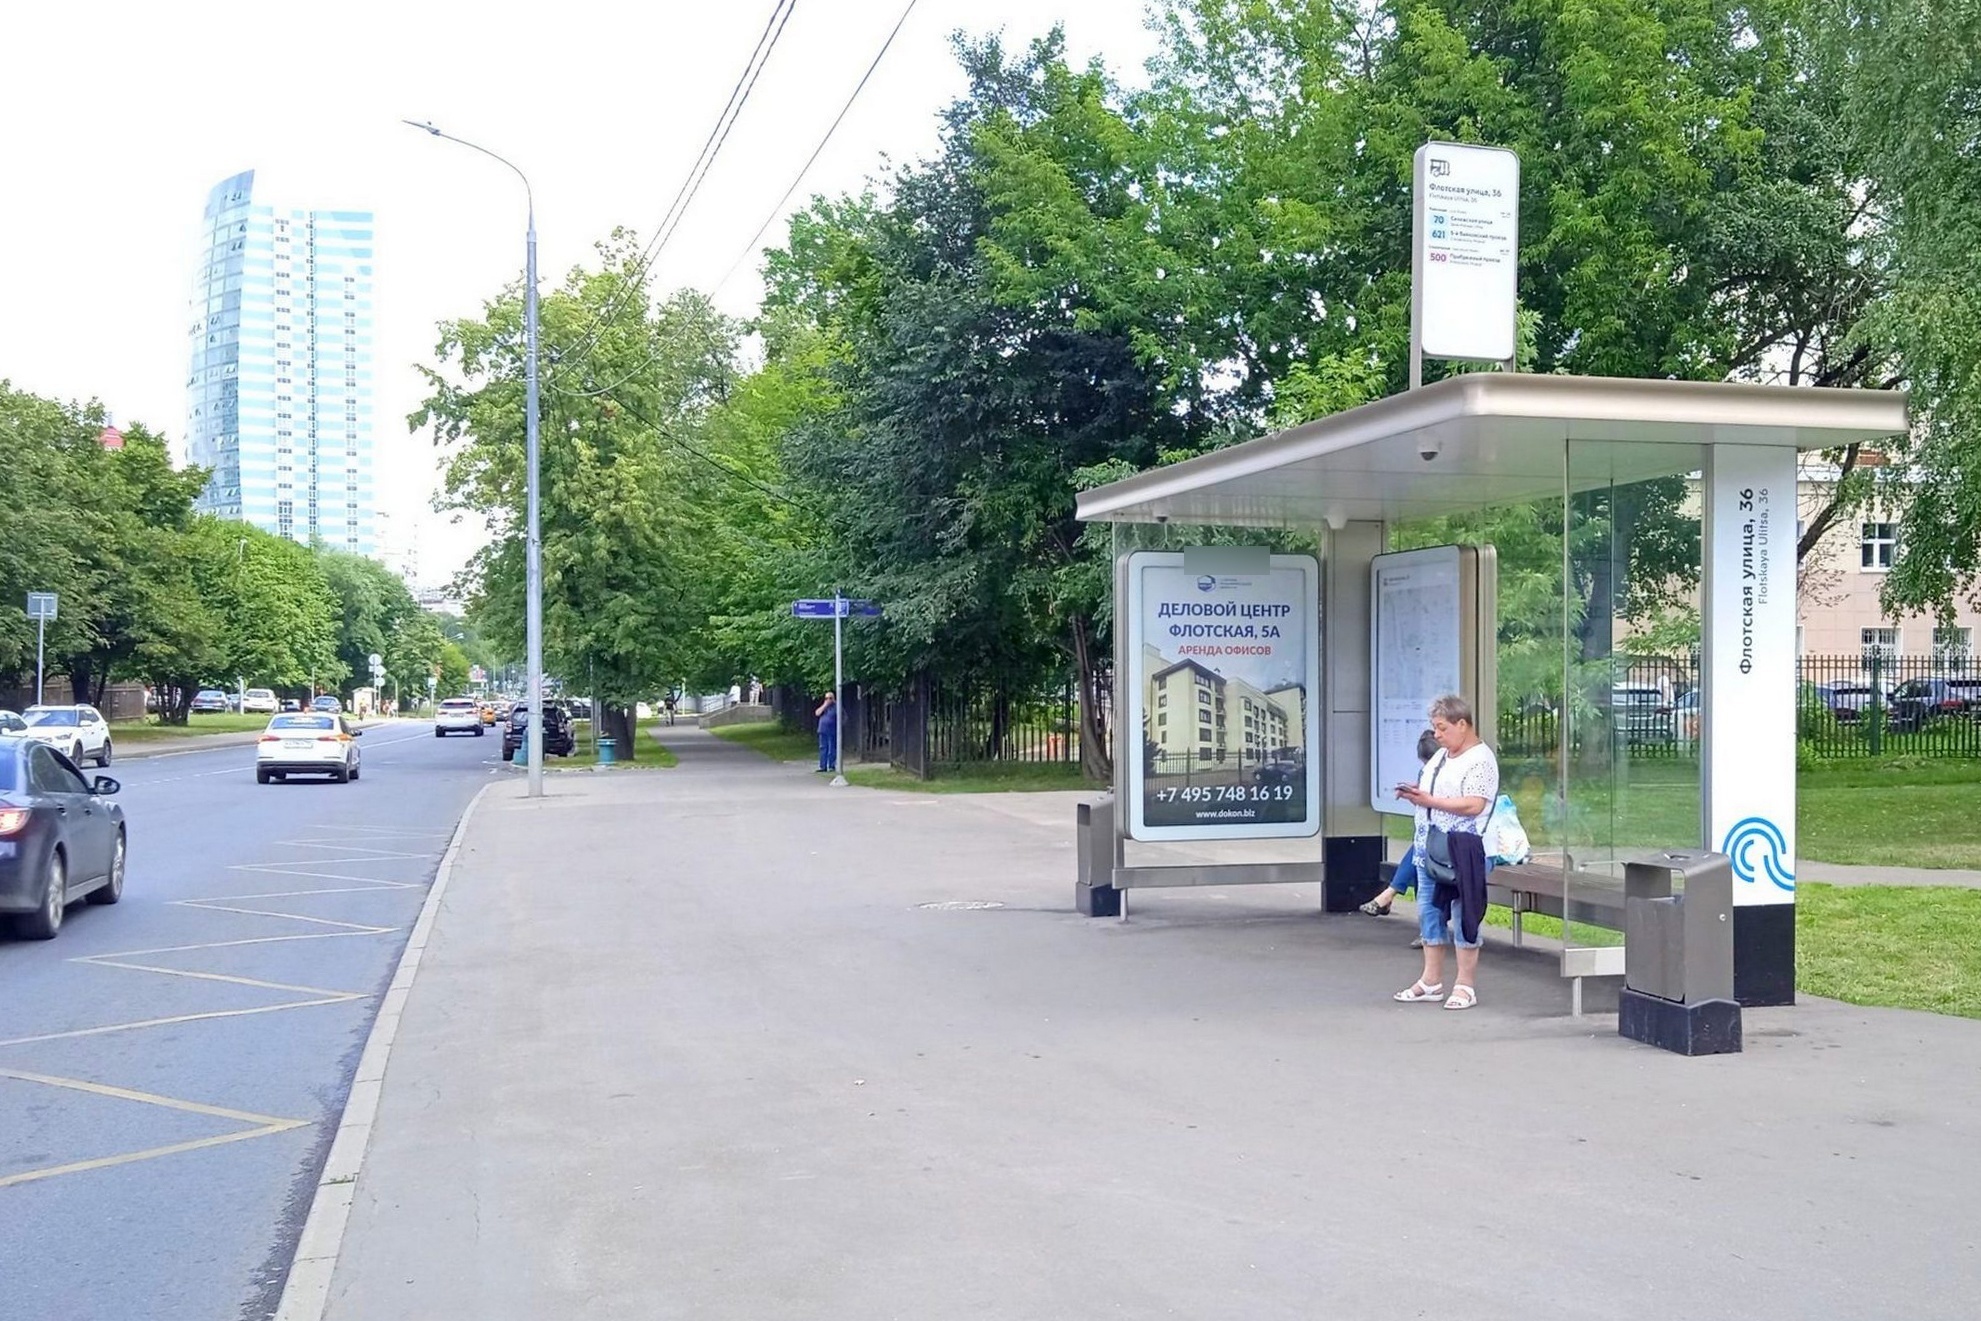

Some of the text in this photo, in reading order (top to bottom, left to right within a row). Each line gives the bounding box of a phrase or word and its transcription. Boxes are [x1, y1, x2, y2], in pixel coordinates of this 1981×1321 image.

[1434, 215, 1444, 224] 70
[1432, 230, 1446, 239] 621
[1430, 252, 1446, 262] 500
[1758, 488, 1770, 605] Flotskaya Ulitsa, 36
[1740, 488, 1756, 674] Флотская улица, 36
[1158, 600, 1291, 620] ДЕЛОВОЙ ЦЕНТР
[1169, 624, 1281, 640] ФЛОТСКАЯ, 5А
[1178, 645, 1272, 656] АРЕНДА ОФИСОВ
[1156, 785, 1293, 802] +7 495 748 16 19
[1195, 808, 1256, 818] www.dokon.biz
